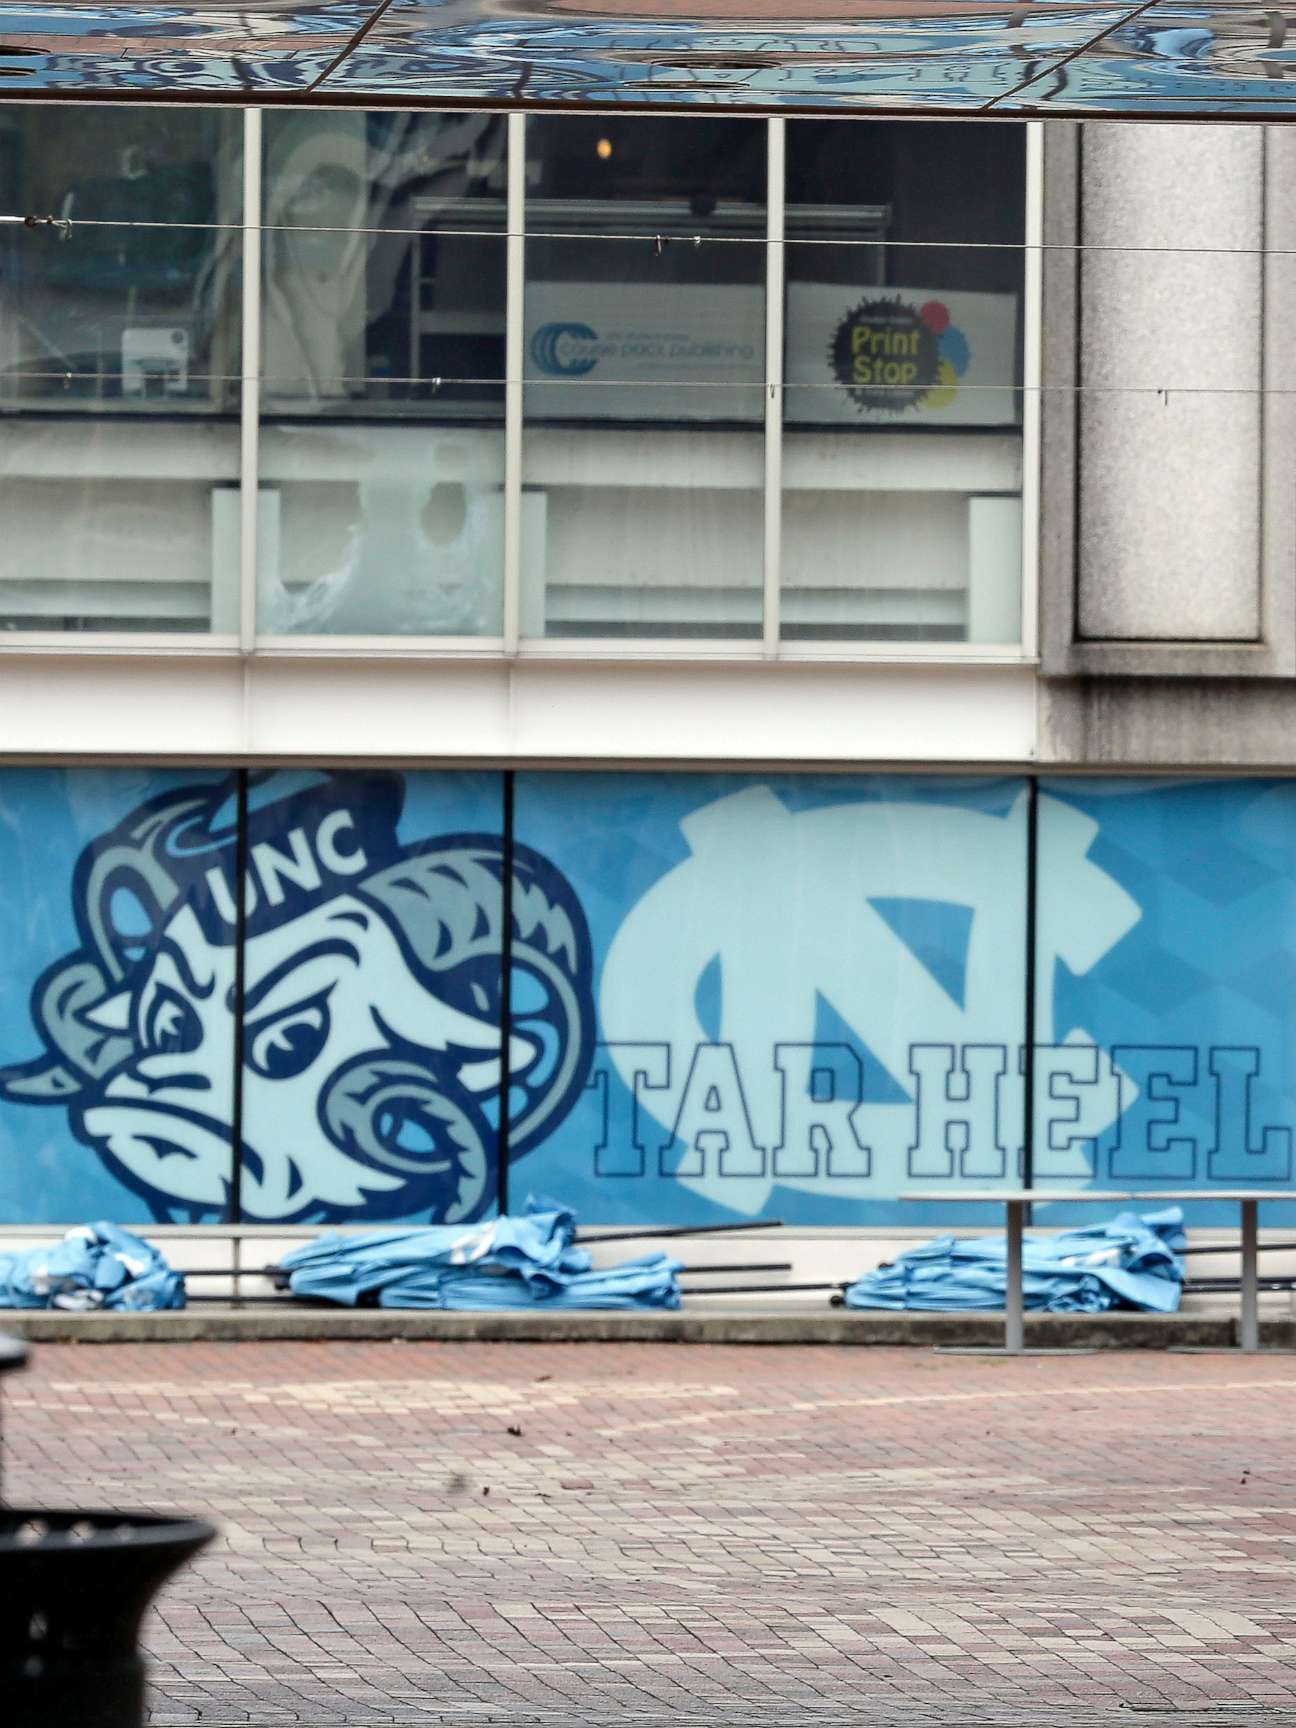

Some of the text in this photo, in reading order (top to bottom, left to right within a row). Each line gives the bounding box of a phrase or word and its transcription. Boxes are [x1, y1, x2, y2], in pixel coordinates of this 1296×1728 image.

[851, 326, 920, 355] Print
[853, 355, 918, 385] Stop
[205, 809, 368, 925] UNC
[585, 1042, 871, 1178] TAR
